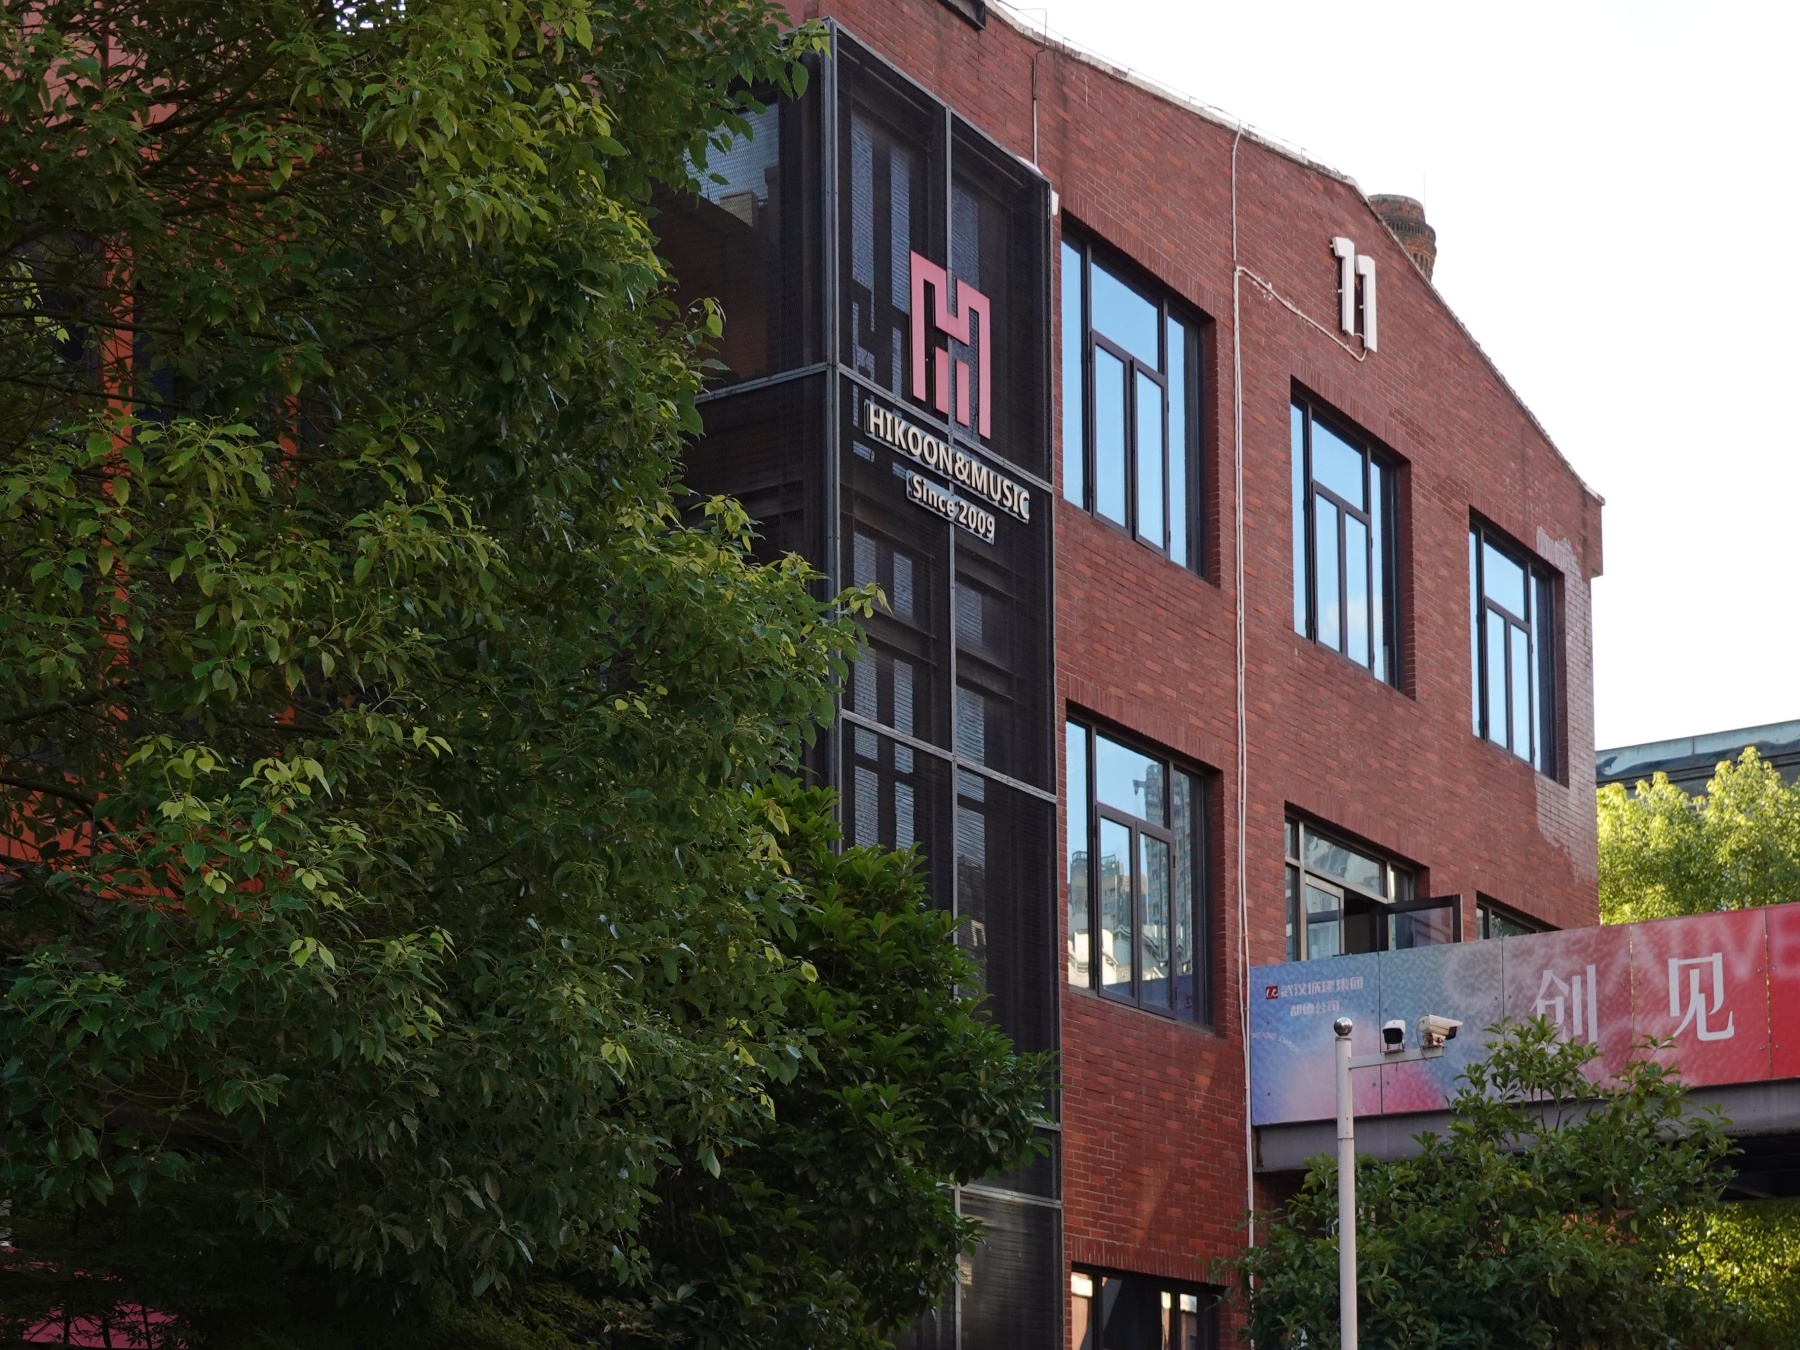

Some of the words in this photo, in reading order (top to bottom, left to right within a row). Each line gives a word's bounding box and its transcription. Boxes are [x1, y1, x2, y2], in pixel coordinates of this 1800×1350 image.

[1332, 237, 1378, 353] 11
[869, 403, 1030, 520] HIKOON&MUSIC
[912, 475, 955, 518] Since
[958, 501, 995, 539] 2009
[1280, 976, 1364, 998] 武汉城建集团
